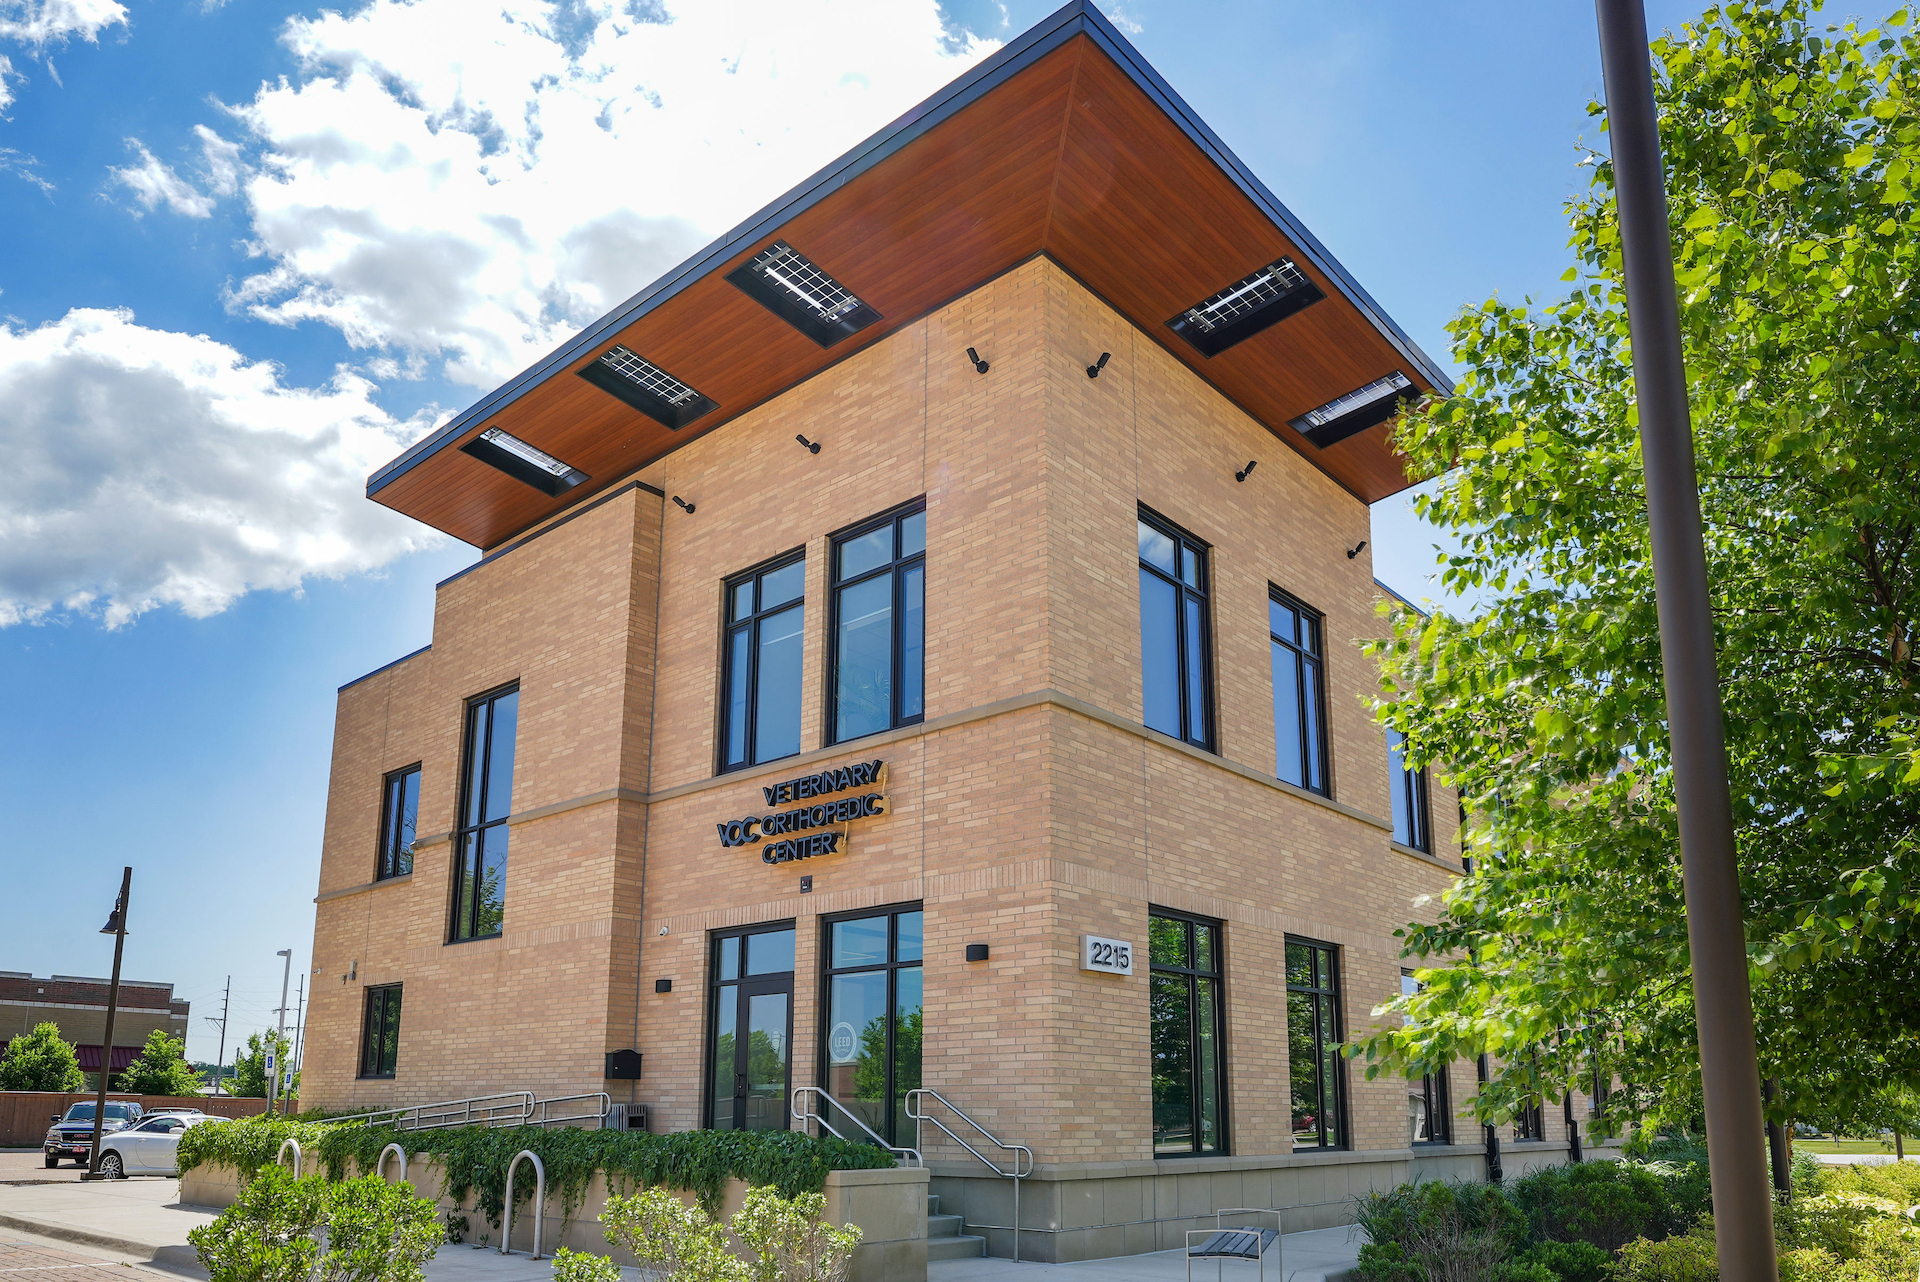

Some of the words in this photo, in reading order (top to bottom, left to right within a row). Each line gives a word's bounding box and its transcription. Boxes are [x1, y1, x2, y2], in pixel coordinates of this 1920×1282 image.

[763, 759, 883, 807] VETERINARY
[761, 793, 884, 836] ORTHOPEDIC
[717, 816, 761, 847] VOC
[762, 832, 838, 864] CENTER
[1091, 942, 1129, 969] 2215
[834, 1036, 850, 1047] LEED
